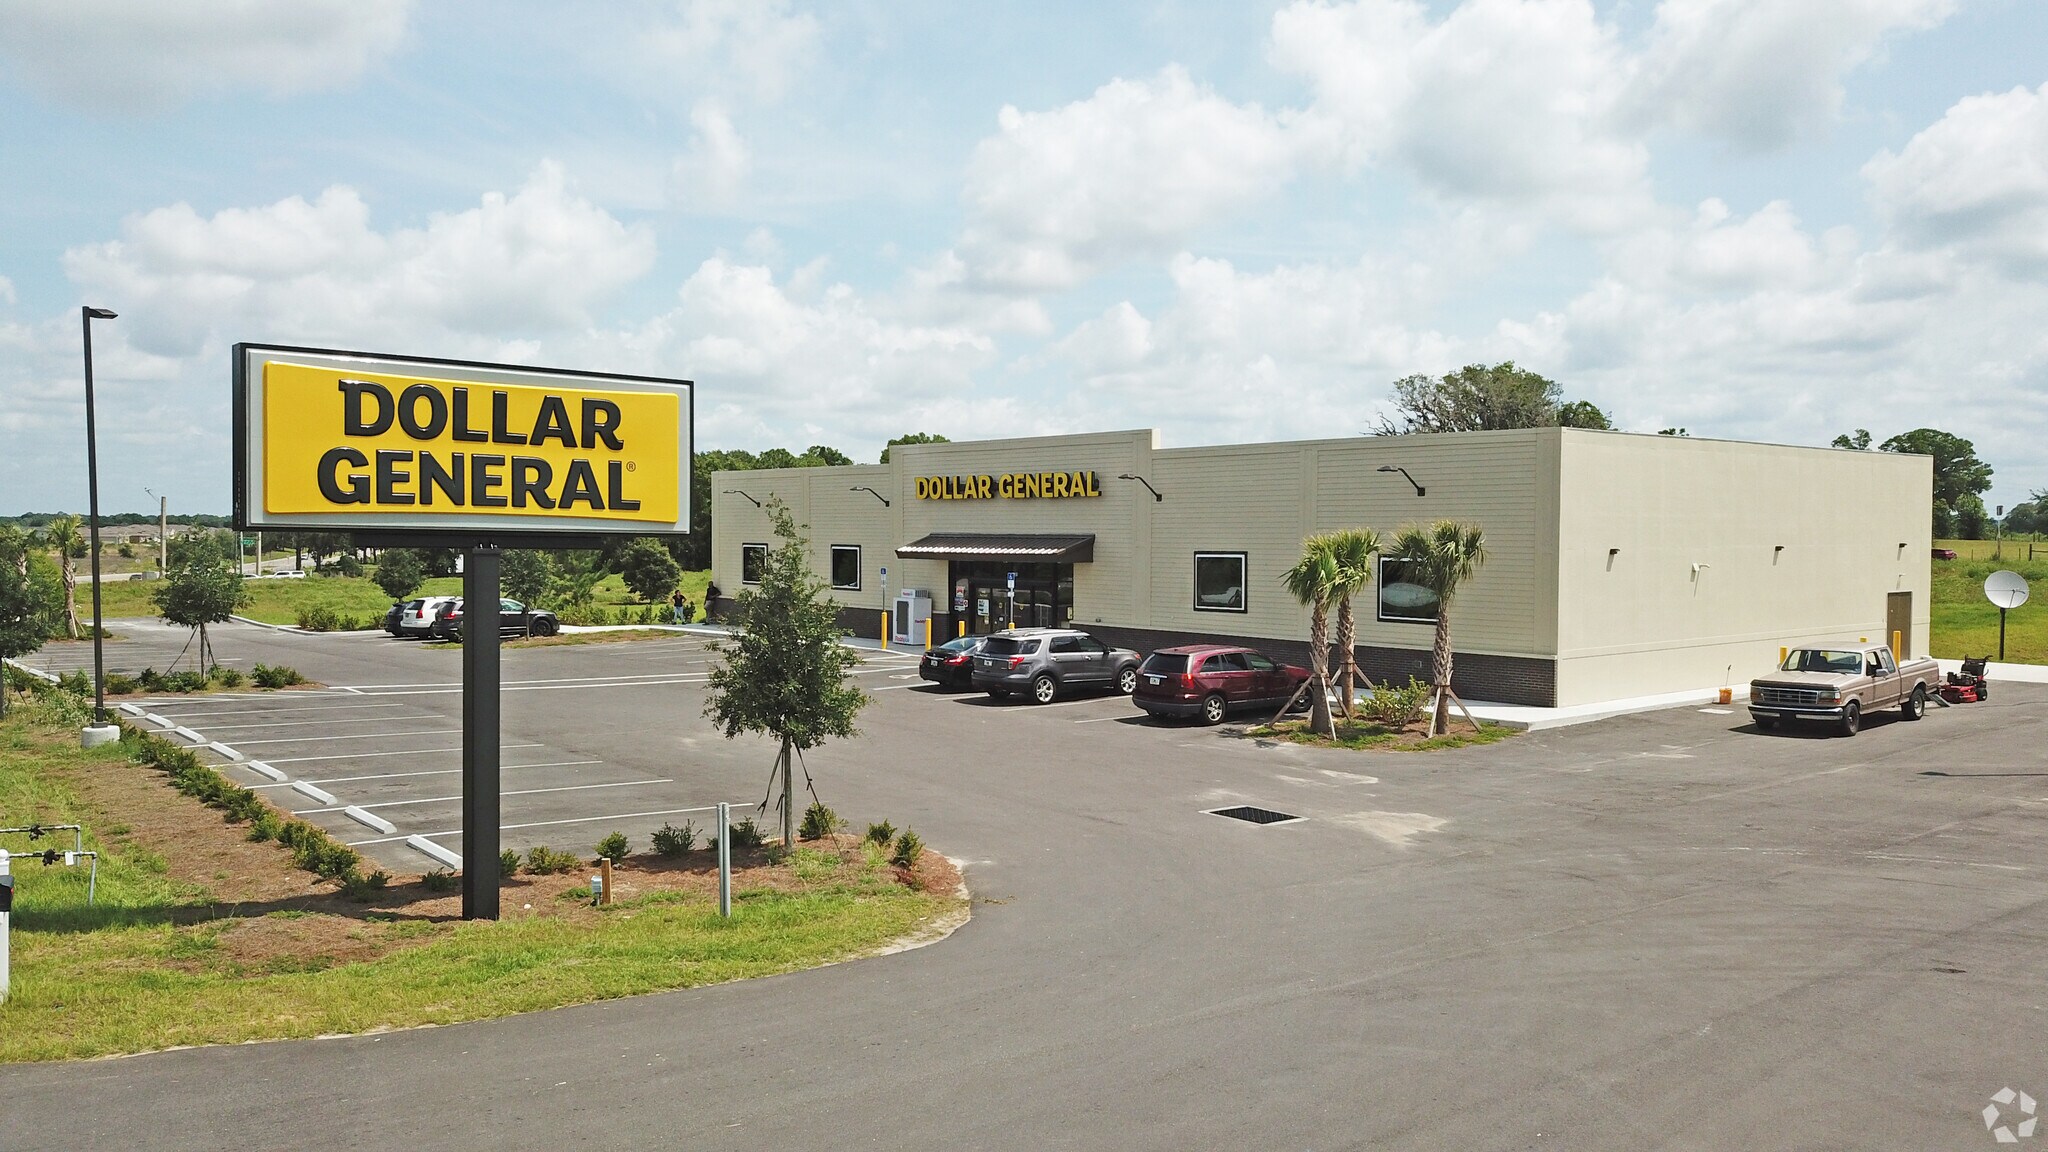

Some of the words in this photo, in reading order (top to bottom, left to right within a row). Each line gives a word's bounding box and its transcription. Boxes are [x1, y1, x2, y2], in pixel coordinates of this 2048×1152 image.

[338, 378, 624, 451] DOLLAR
[914, 474, 994, 500] DOLLAR
[998, 470, 1102, 499] GENERAL
